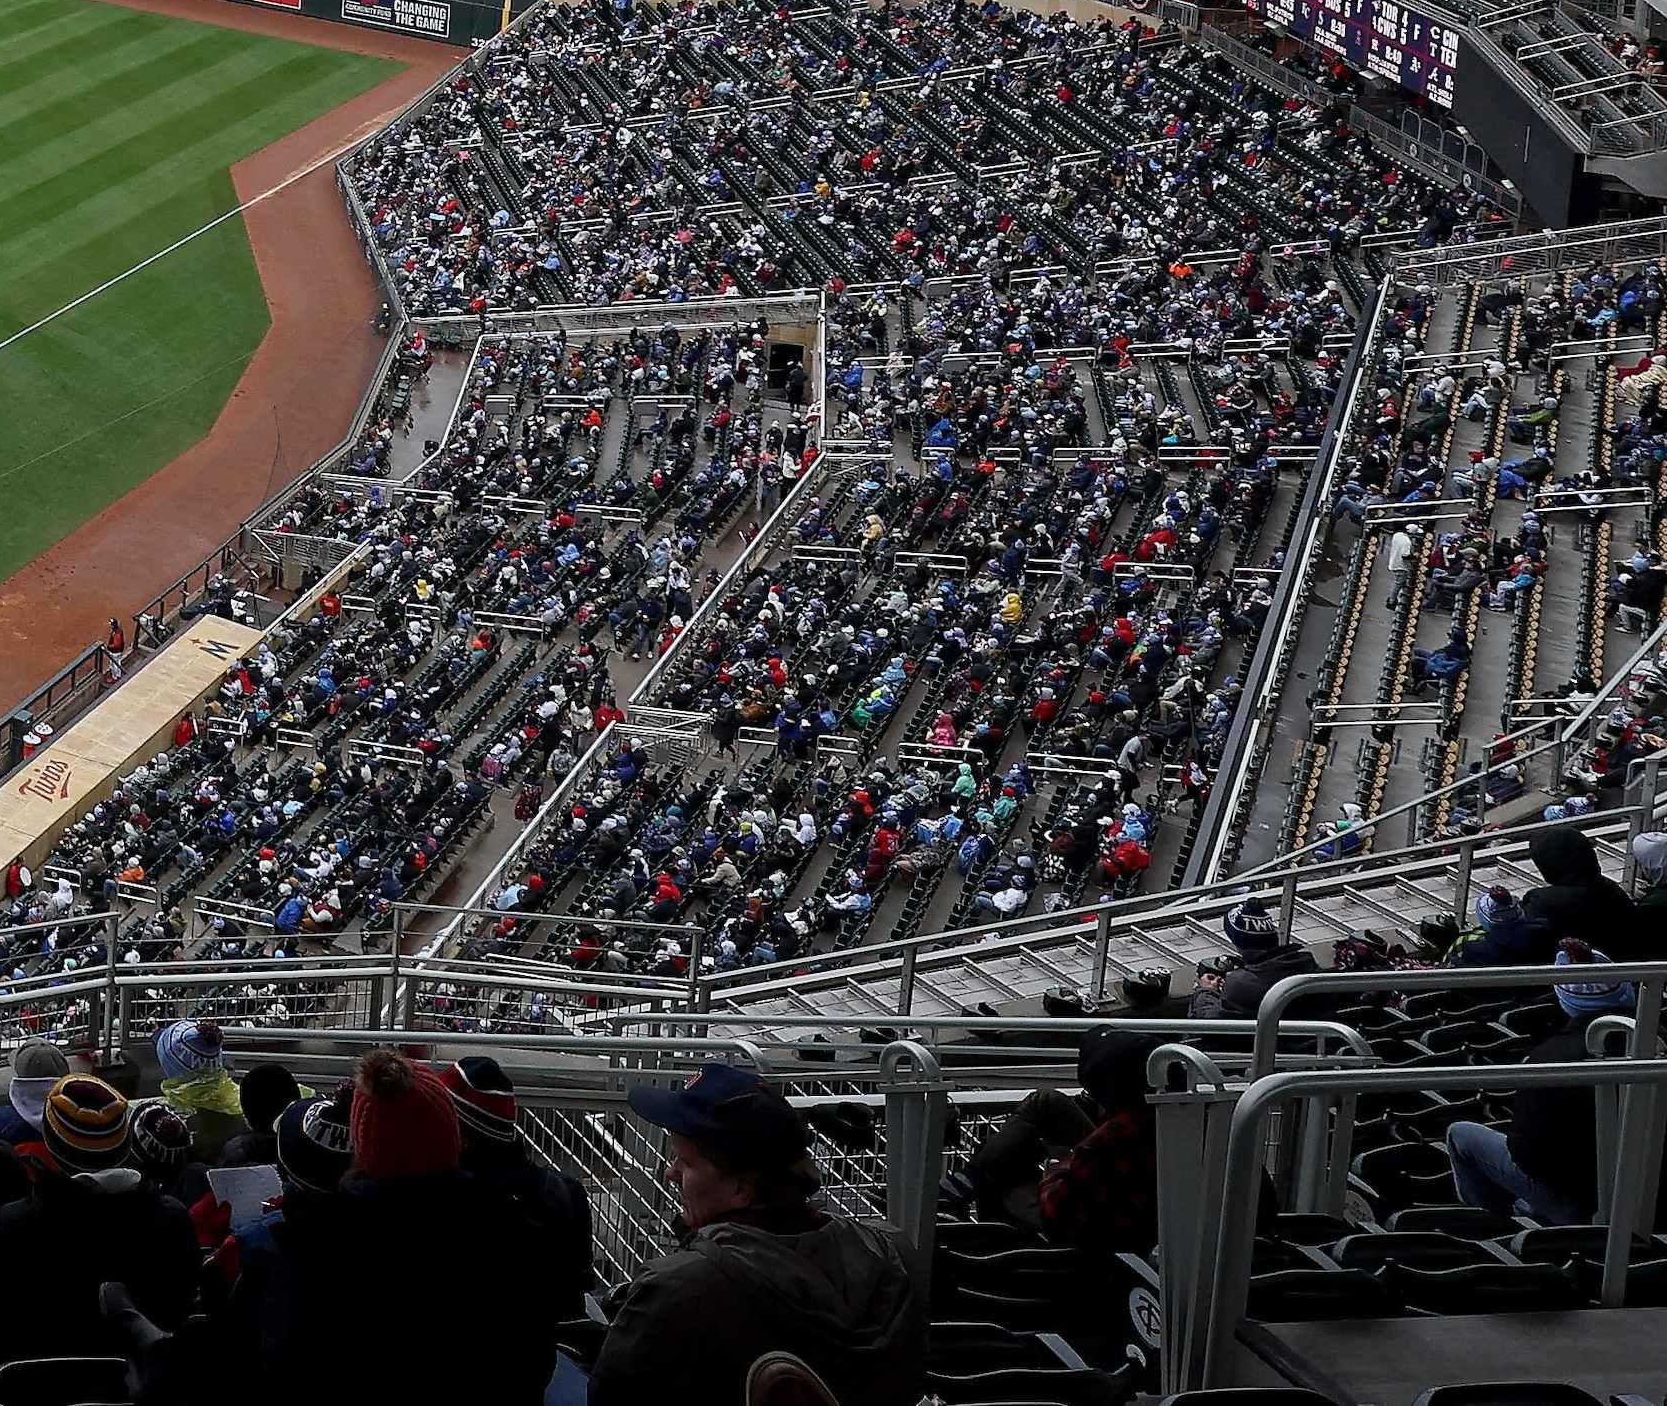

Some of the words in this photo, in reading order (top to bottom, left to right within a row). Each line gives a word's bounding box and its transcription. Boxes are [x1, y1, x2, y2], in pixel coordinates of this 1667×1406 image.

[394, 0, 446, 20] CHANGING
[395, 12, 415, 27] THE
[416, 16, 445, 32] GAME
